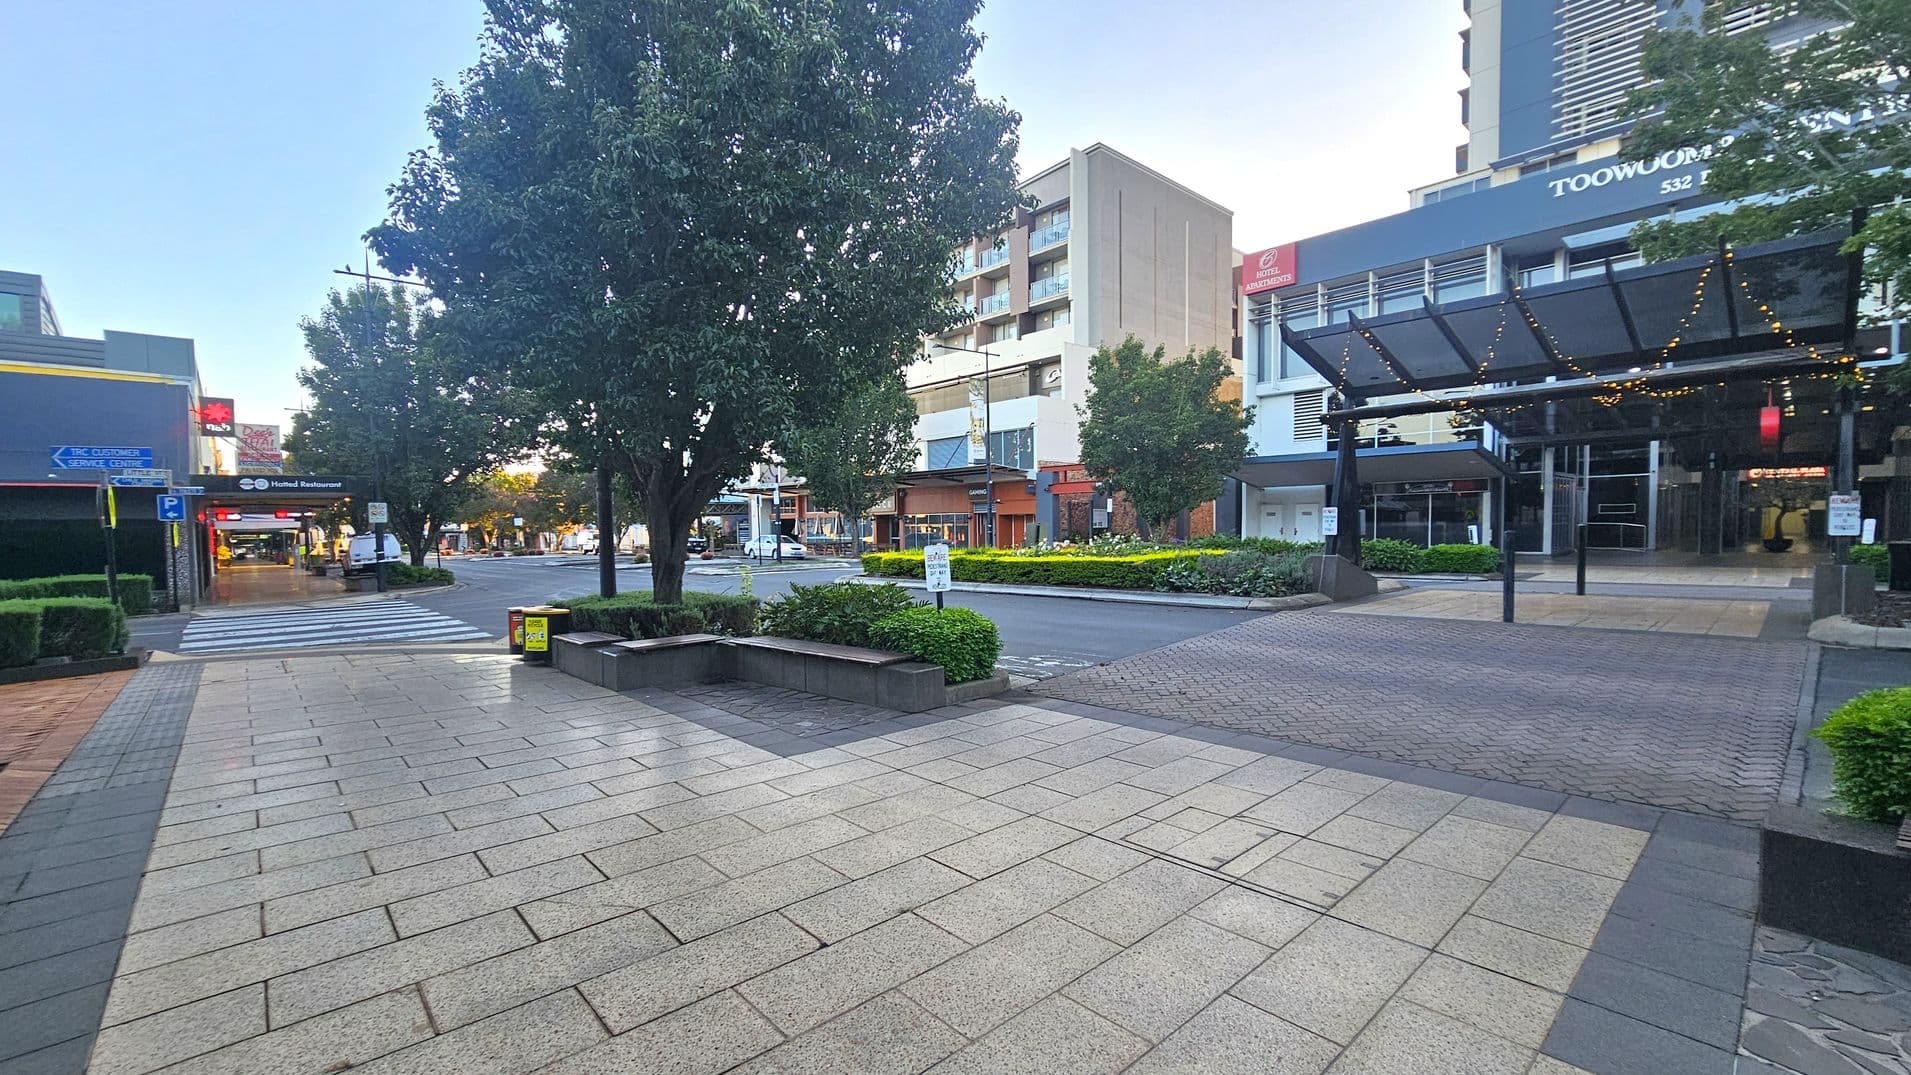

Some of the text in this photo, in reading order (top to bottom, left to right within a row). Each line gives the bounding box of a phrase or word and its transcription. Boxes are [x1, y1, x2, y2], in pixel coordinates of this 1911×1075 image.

[1549, 135, 1736, 198] TOOWOOMB
[1660, 175, 1693, 195] 532
[1256, 267, 1281, 279] HOTEL
[1245, 274, 1292, 291] APARTMENTS
[71, 448, 140, 457] TRC CUSTOMER
[68, 459, 144, 468] SERVICE CENTRE
[271, 480, 342, 488] Hatted Restaurant
[164, 497, 178, 509] P
[927, 553, 947, 562] BEWARE
